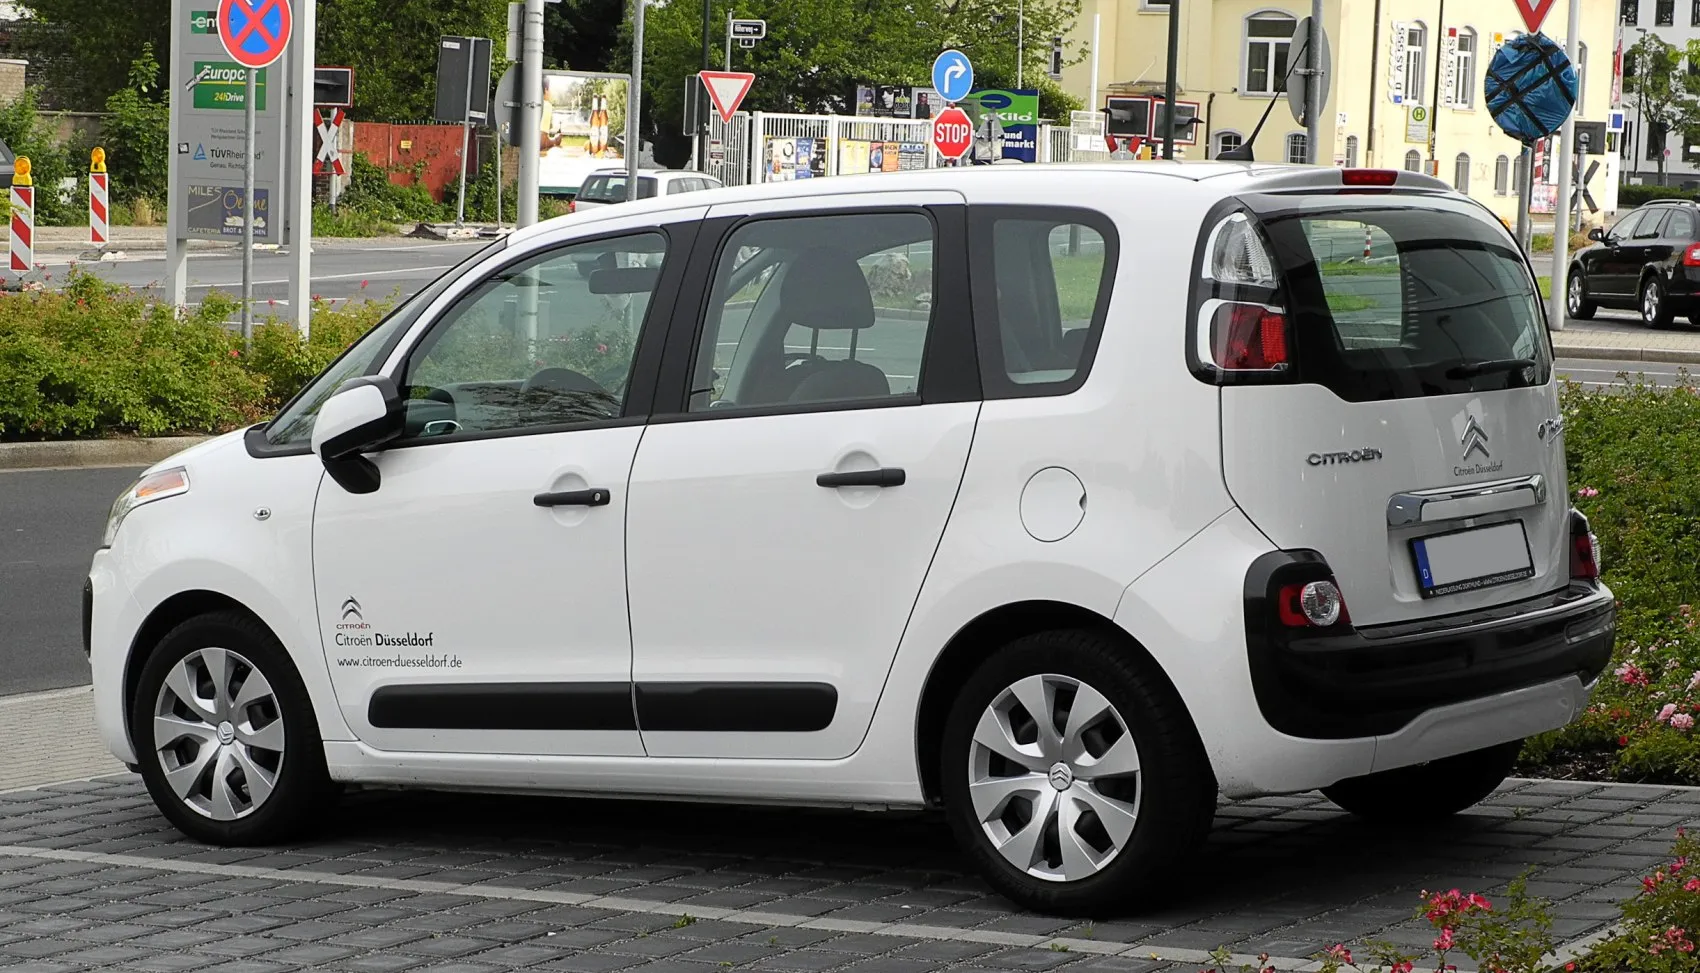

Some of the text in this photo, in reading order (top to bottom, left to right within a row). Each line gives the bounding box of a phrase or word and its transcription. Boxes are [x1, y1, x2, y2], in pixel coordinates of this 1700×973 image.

[936, 123, 969, 143] STOP
[1003, 131, 1022, 139] und
[188, 186, 222, 196] MILES
[1423, 569, 1429, 579] D
[335, 632, 433, 647] Citroën Düsseldorf
[337, 654, 462, 668] www.citroen-duesseldorf.de
